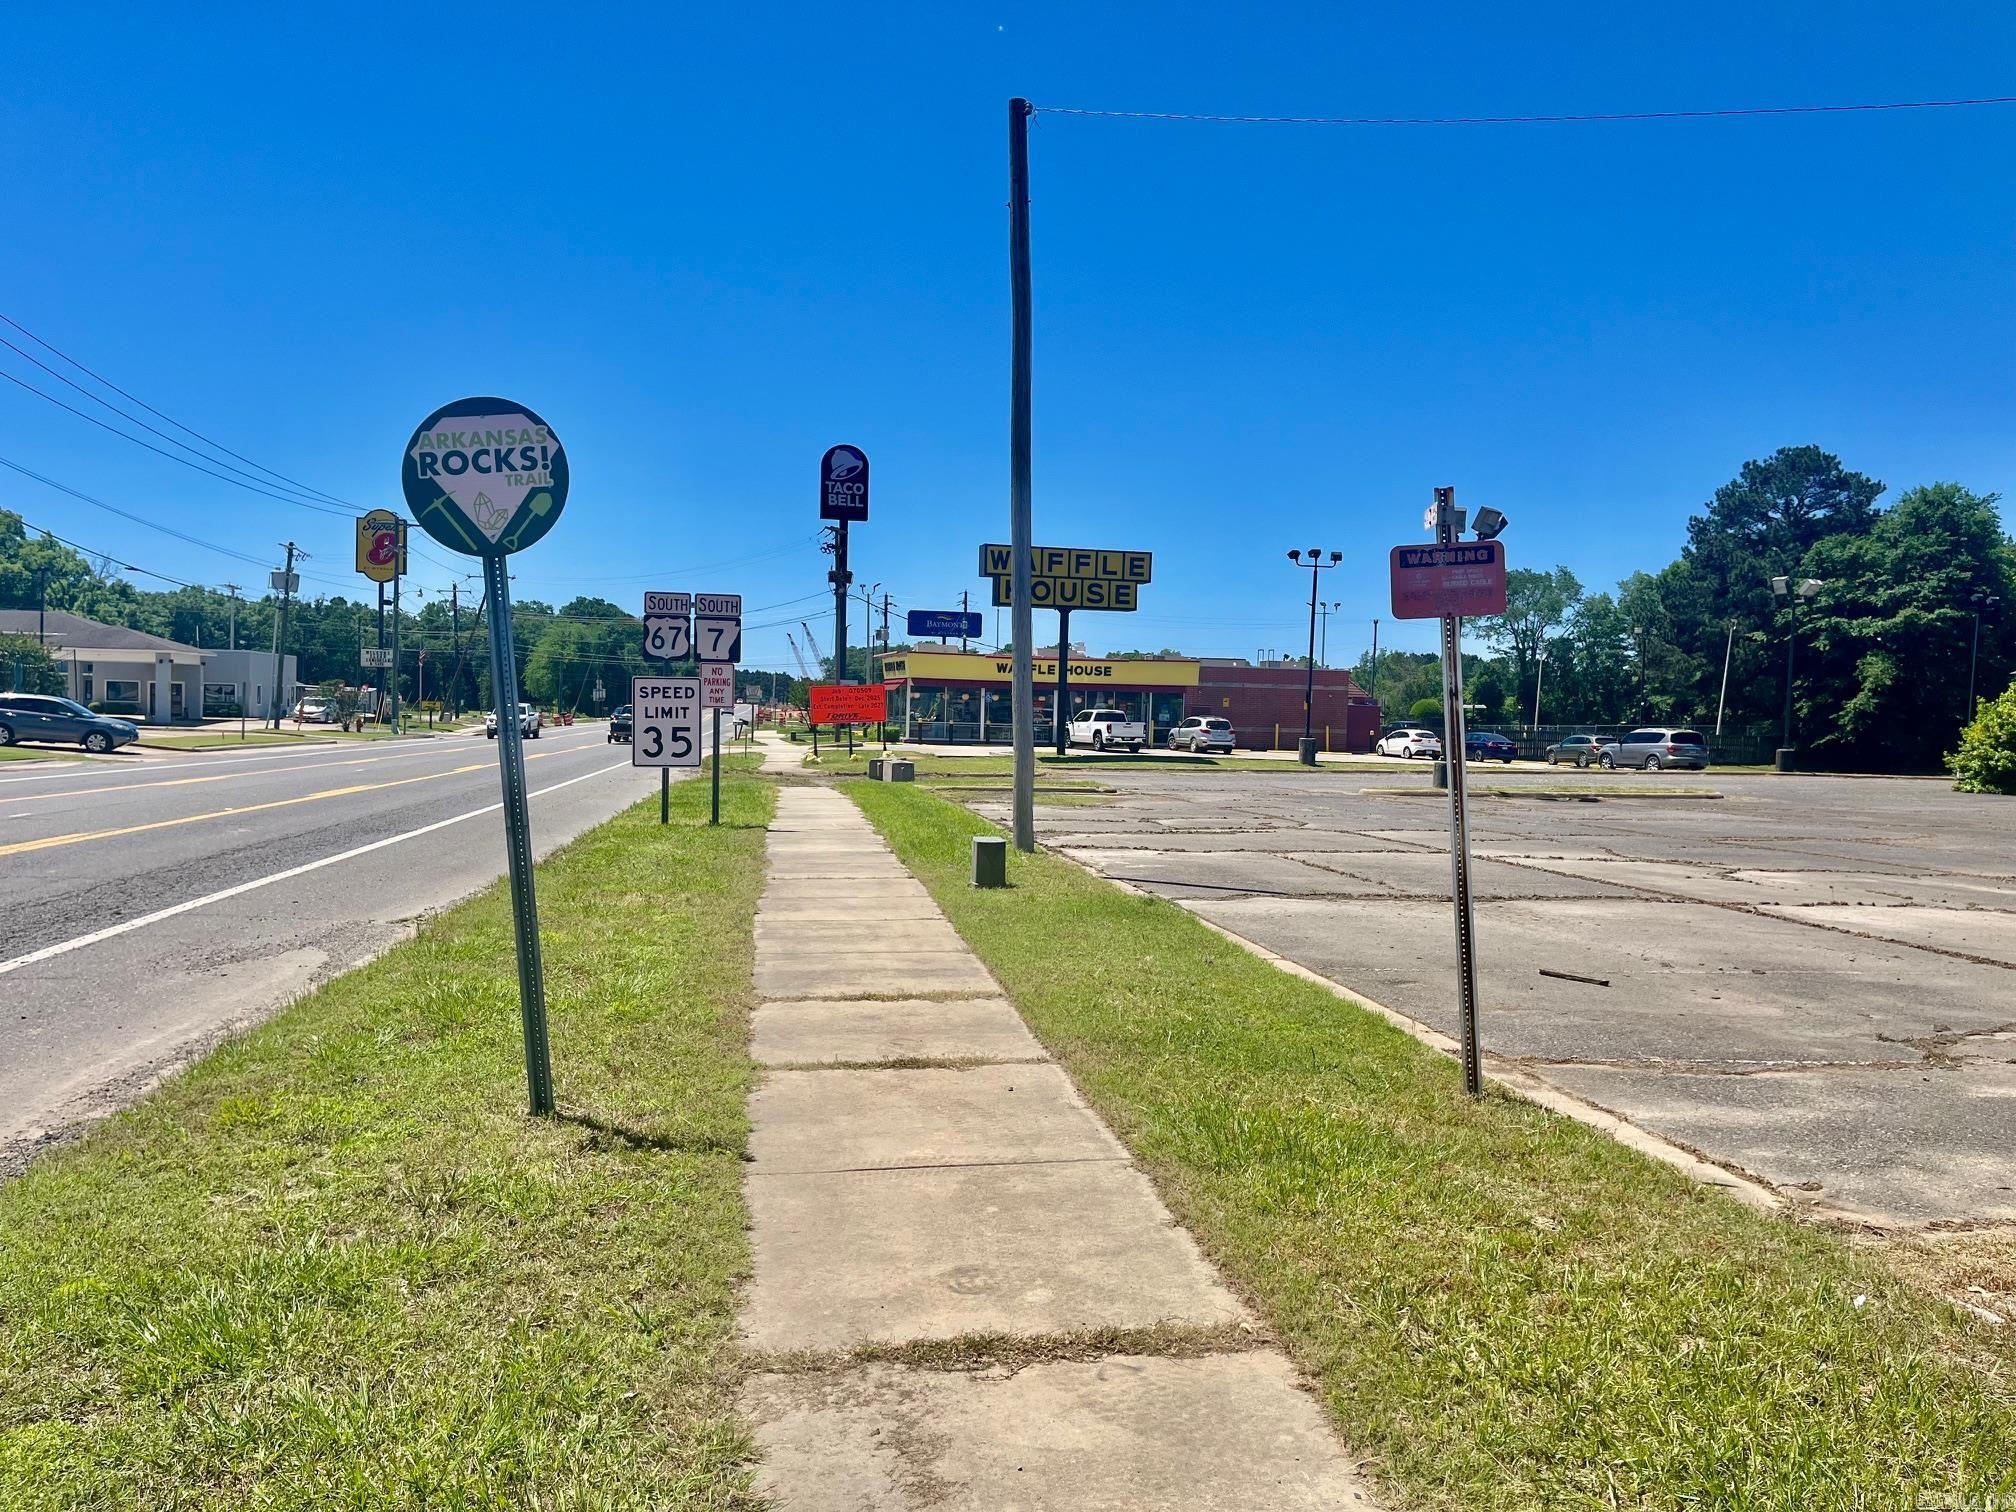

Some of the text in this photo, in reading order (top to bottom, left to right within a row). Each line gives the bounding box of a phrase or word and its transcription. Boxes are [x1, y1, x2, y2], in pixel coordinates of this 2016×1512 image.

[419, 427, 548, 450] ARKANSAS
[418, 446, 552, 477] ROCKS!
[505, 473, 552, 487] TRAIL
[825, 481, 865, 495] TACO
[828, 494, 864, 507] BELL
[1406, 549, 1489, 565] WARNING
[648, 595, 688, 612] SOUTH
[698, 597, 739, 614] SOUTH
[651, 626, 682, 650] 67
[707, 628, 724, 652] 7
[711, 667, 723, 676] NO
[996, 662, 1056, 675] WFLE
[703, 678, 731, 687] PARKING
[639, 686, 695, 699] SPEED
[644, 706, 690, 719] LIMIT
[642, 726, 693, 758] 35
